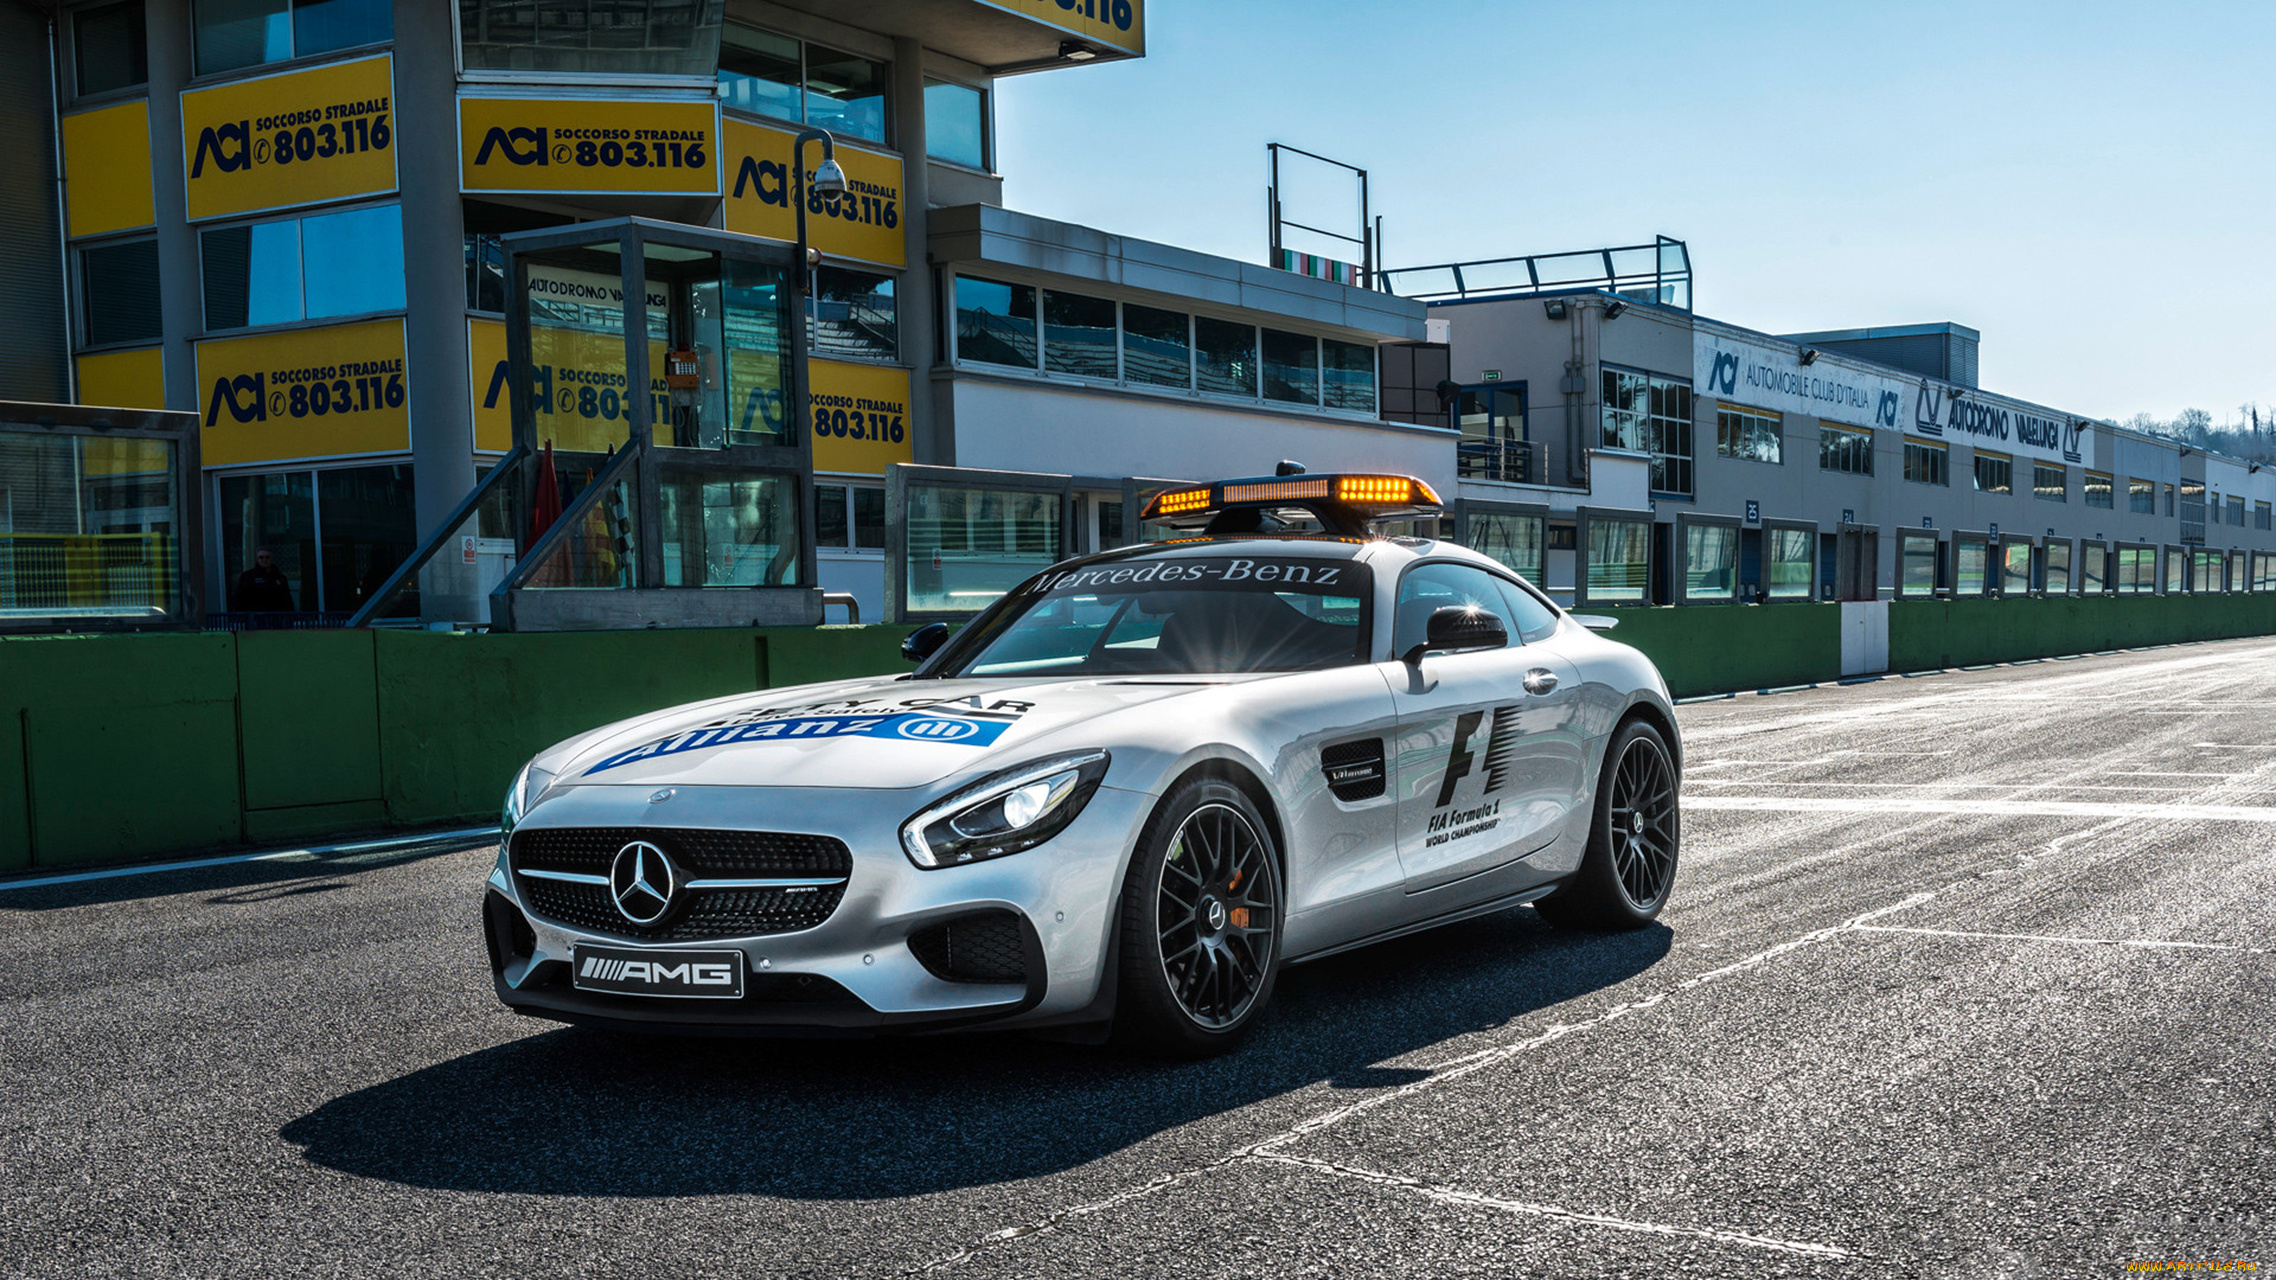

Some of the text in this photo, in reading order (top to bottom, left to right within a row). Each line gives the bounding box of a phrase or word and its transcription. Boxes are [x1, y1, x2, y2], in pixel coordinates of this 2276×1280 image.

[256, 97, 388, 131] SOCCORSO STRADALE
[190, 119, 252, 179] ACI
[274, 114, 391, 165] 803.116
[473, 126, 549, 166] ACI
[554, 128, 704, 141] SOCCORSO STRADALE
[575, 140, 706, 169] 803.116
[849, 179, 897, 200] STRADALE
[528, 278, 607, 300] AUTODROMO
[271, 358, 402, 385] SOCCORSO STRADALE
[559, 368, 626, 387] SOCCORSO
[1746, 363, 1869, 409] AUTOMOBILE CLUB D'ITALIA
[205, 372, 267, 427] ACI
[289, 373, 404, 418] 803.116
[856, 398, 903, 414] STRADALE
[815, 407, 904, 444] 803.116
[1022, 559, 1342, 596] Mercedes-Benz
[899, 694, 1036, 713] CAR
[608, 717, 885, 766] Allianz
[1427, 799, 1500, 833] FIA Formula 1
[1426, 832, 1449, 848] WORLD
